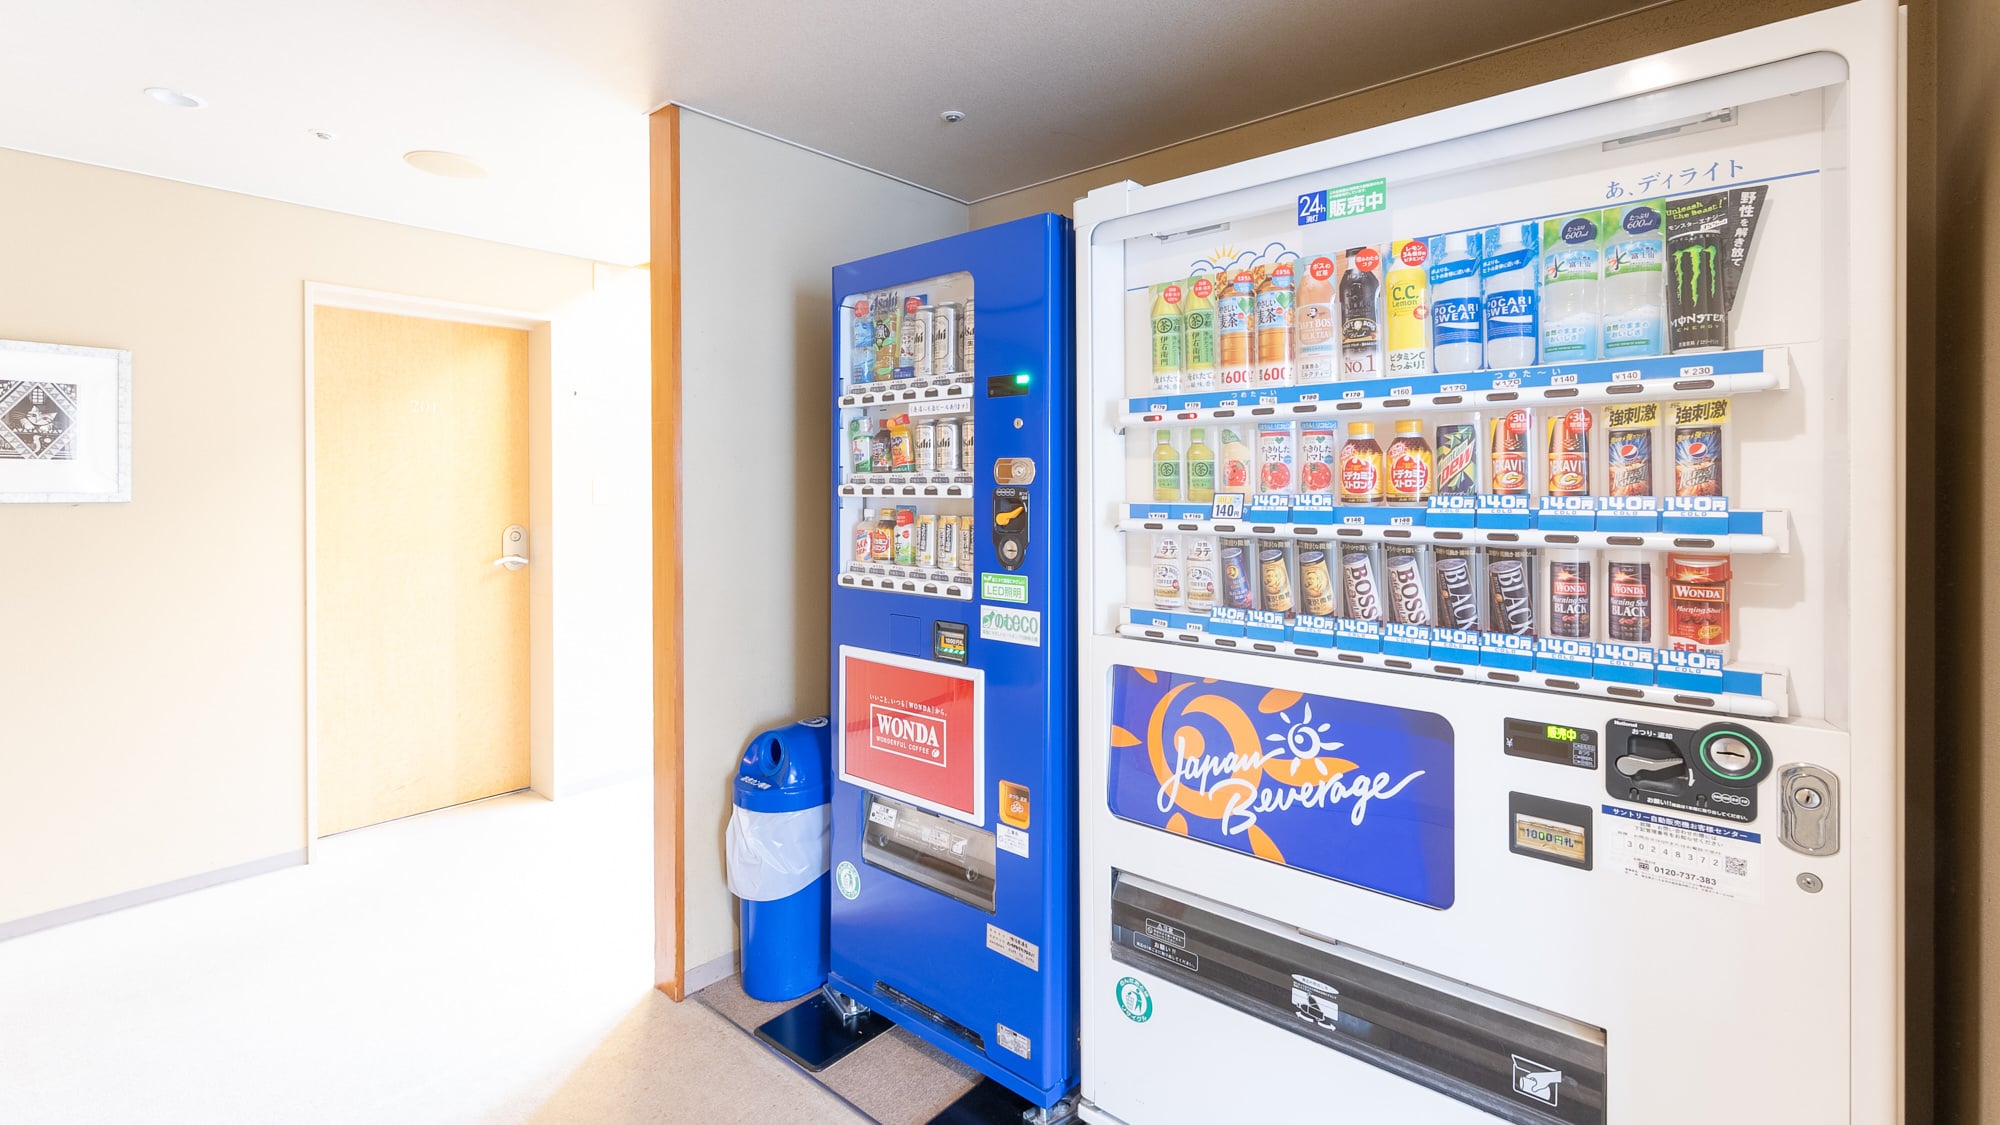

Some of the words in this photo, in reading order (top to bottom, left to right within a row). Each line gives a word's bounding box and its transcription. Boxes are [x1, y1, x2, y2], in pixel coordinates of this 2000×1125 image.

[1605, 159, 1744, 200] あ、ディライト
[1329, 191, 1384, 218] 販売中
[1392, 285, 1420, 302] C.C.
[1434, 304, 1479, 315] POCARI
[1487, 295, 1532, 309] POCARI
[1257, 307, 1277, 324] 麦茶
[1434, 312, 1476, 323] SWEAT
[1487, 304, 1528, 318] SWEAT
[1345, 354, 1376, 374] NO.1
[1390, 351, 1425, 362] ビタミンC
[1615, 371, 1639, 380] ¥140
[1609, 403, 1657, 427] 強刺激
[1675, 400, 1728, 425] 強刺激
[1253, 495, 1289, 506] 140円
[1295, 495, 1332, 506] 140円
[1429, 496, 1474, 508] 140円
[1479, 495, 1528, 508] 140円
[1541, 496, 1594, 510] 140円
[1599, 497, 1656, 511] 140円
[1665, 497, 1726, 511] 140円
[1215, 504, 1240, 517] 140円
[986, 584, 1022, 599] LED照明
[1350, 563, 1378, 620] BOSS
[1396, 566, 1426, 624] BOSS
[1556, 583, 1586, 593] WONDA
[1613, 584, 1644, 595] WONDA
[1675, 585, 1721, 599] WONDA
[1443, 566, 1479, 630] BLACK
[1497, 569, 1534, 635] BLACK
[1212, 607, 1245, 620] 140円
[1554, 603, 1587, 614] BLACK
[1612, 605, 1647, 617] BLACK
[1247, 610, 1283, 624] 140円
[1296, 615, 1334, 629] 140円
[1338, 619, 1378, 634] 140円
[1386, 623, 1429, 639] 140円
[1433, 628, 1478, 645] 140円
[1482, 633, 1532, 649] 140円
[1538, 638, 1591, 656] 140円
[1596, 644, 1652, 662] 140円
[1659, 650, 1721, 670] 140円
[876, 712, 940, 748] WONDA
[1546, 725, 1578, 742] 販売中
[876, 735, 907, 750] WONDERFUL
[908, 743, 930, 755] COFFEE
[1157, 736, 1286, 813] Japan
[1208, 769, 1426, 836] Beverage
[1613, 808, 1749, 839] サントリー自動販売機お客様センター
[1525, 828, 1575, 848] 1000円札
[1654, 861, 1717, 886] 0120-737-383
